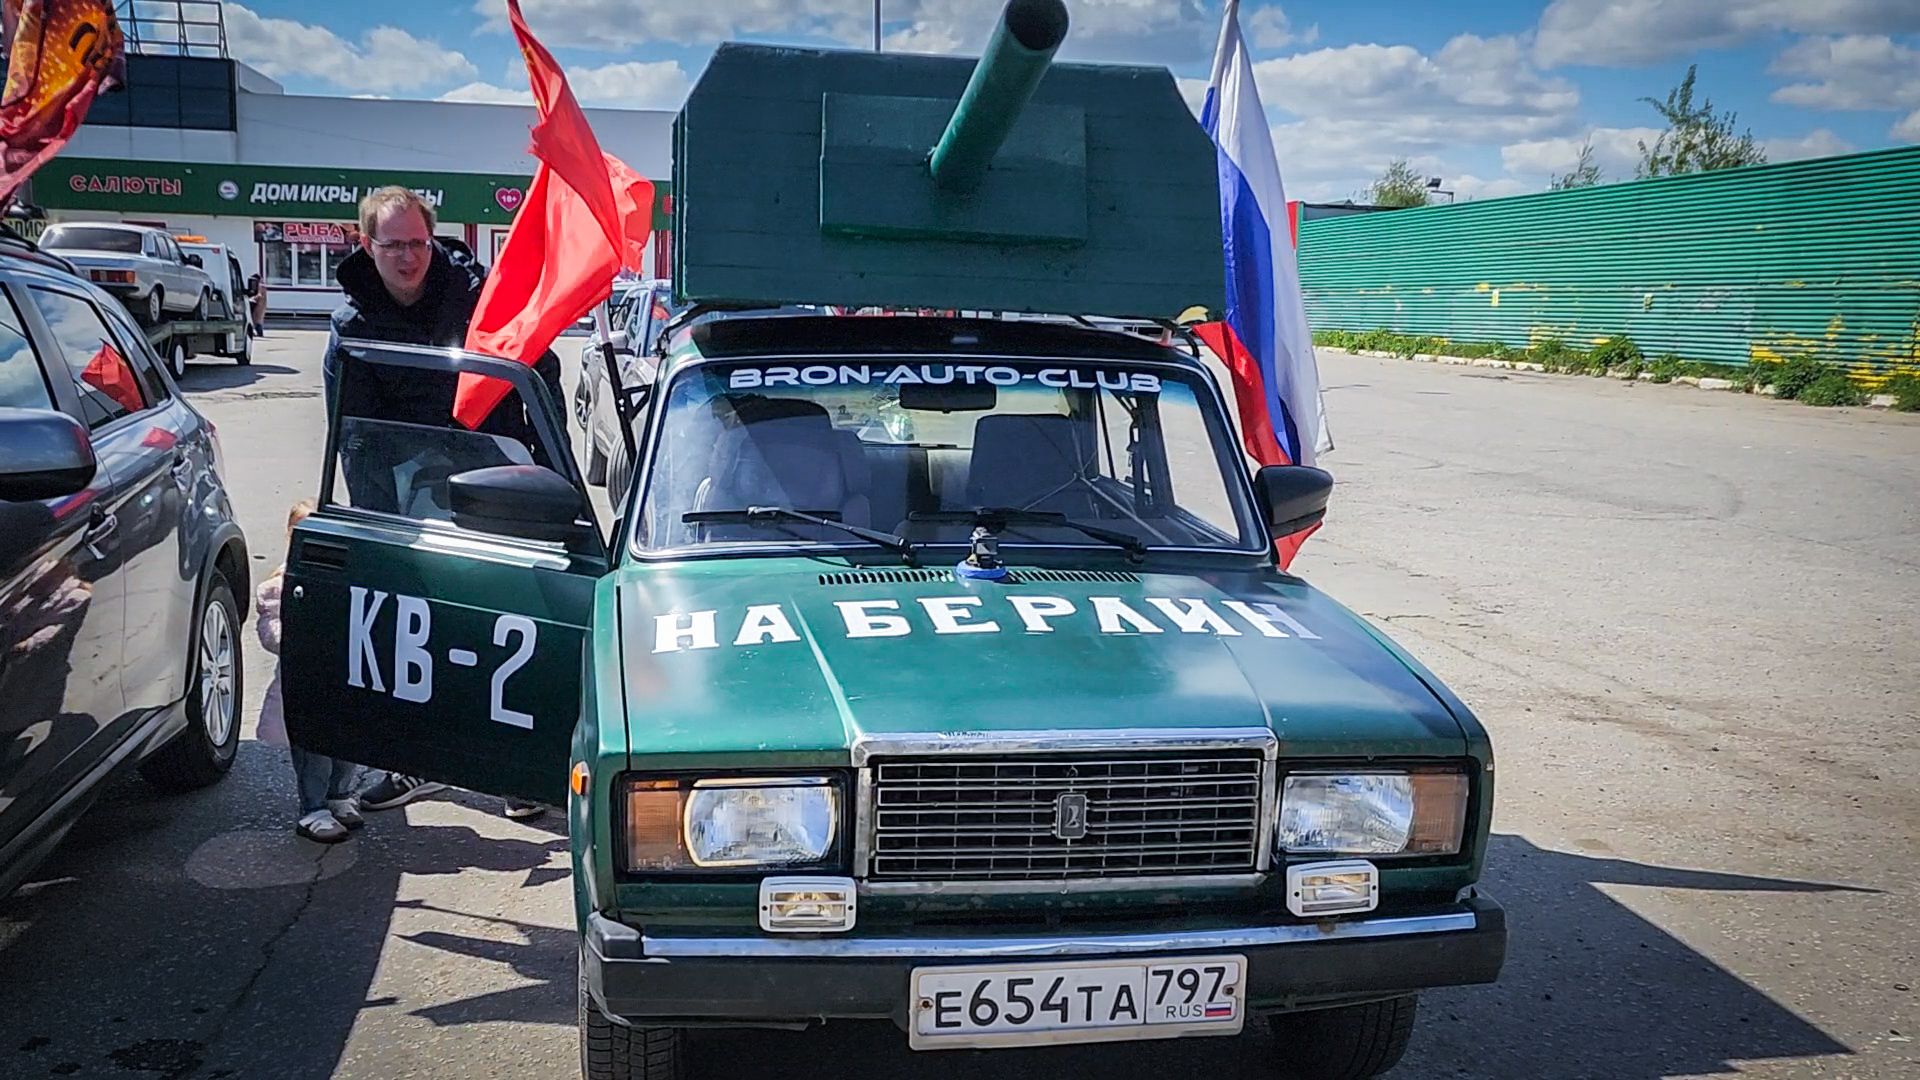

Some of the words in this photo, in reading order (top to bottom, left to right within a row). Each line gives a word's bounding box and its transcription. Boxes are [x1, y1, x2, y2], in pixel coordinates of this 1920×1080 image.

[69, 175, 181, 195] САЛЮТЫ
[250, 182, 299, 203] ДОМ
[301, 184, 358, 203] ИКРЫ
[284, 223, 342, 237] РЫБА
[729, 364, 1162, 393] BRON-AUTO-CLUB
[651, 603, 801, 654] НА
[832, 595, 1322, 640] БЕРЛИН
[348, 585, 537, 729] КВ-2
[935, 976, 1138, 1029] Е654ТА
[1151, 966, 1226, 1005] 797
[1165, 1004, 1203, 1018] RUS
